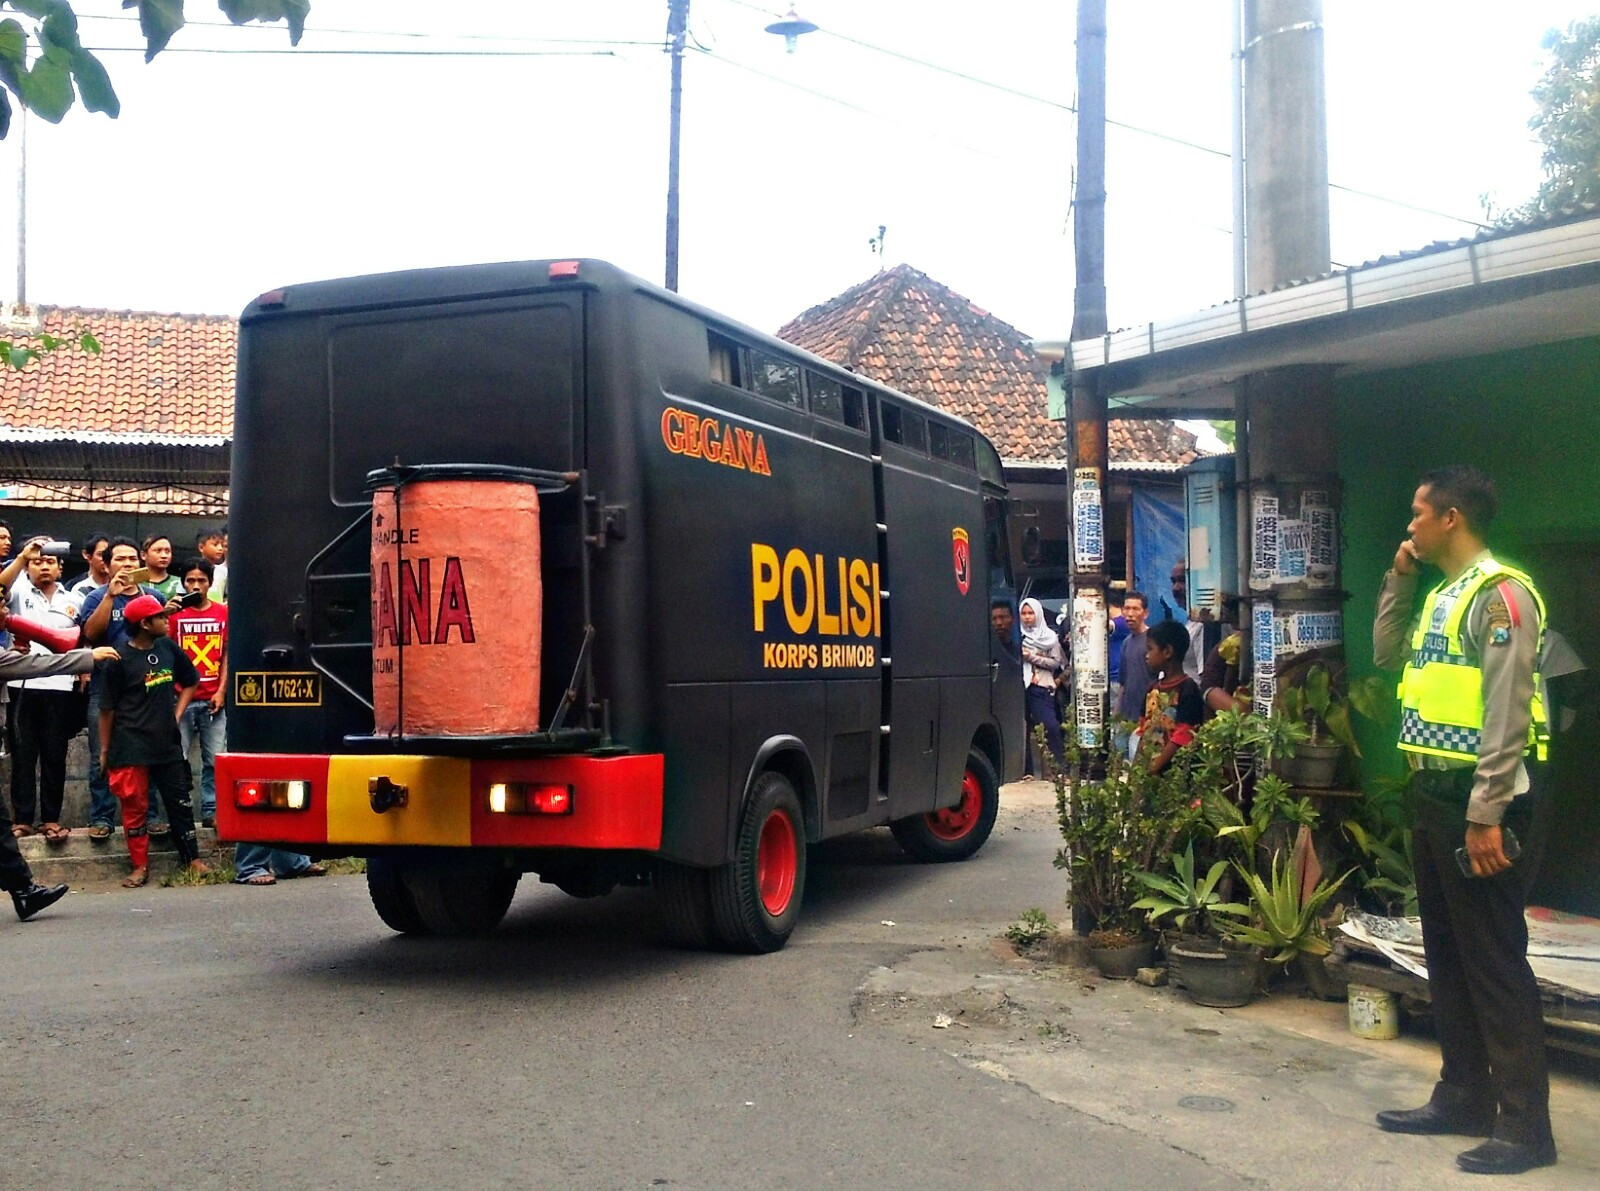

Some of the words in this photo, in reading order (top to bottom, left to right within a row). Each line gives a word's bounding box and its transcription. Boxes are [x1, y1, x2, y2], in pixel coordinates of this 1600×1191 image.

[661, 407, 771, 476] GEGANA
[1263, 552, 1276, 569] 0857
[751, 543, 881, 638] POLISI
[183, 623, 220, 633] WHITE
[764, 643, 818, 669] KORPS
[822, 643, 875, 668] BRIMOB
[272, 679, 314, 698] 17621-X
